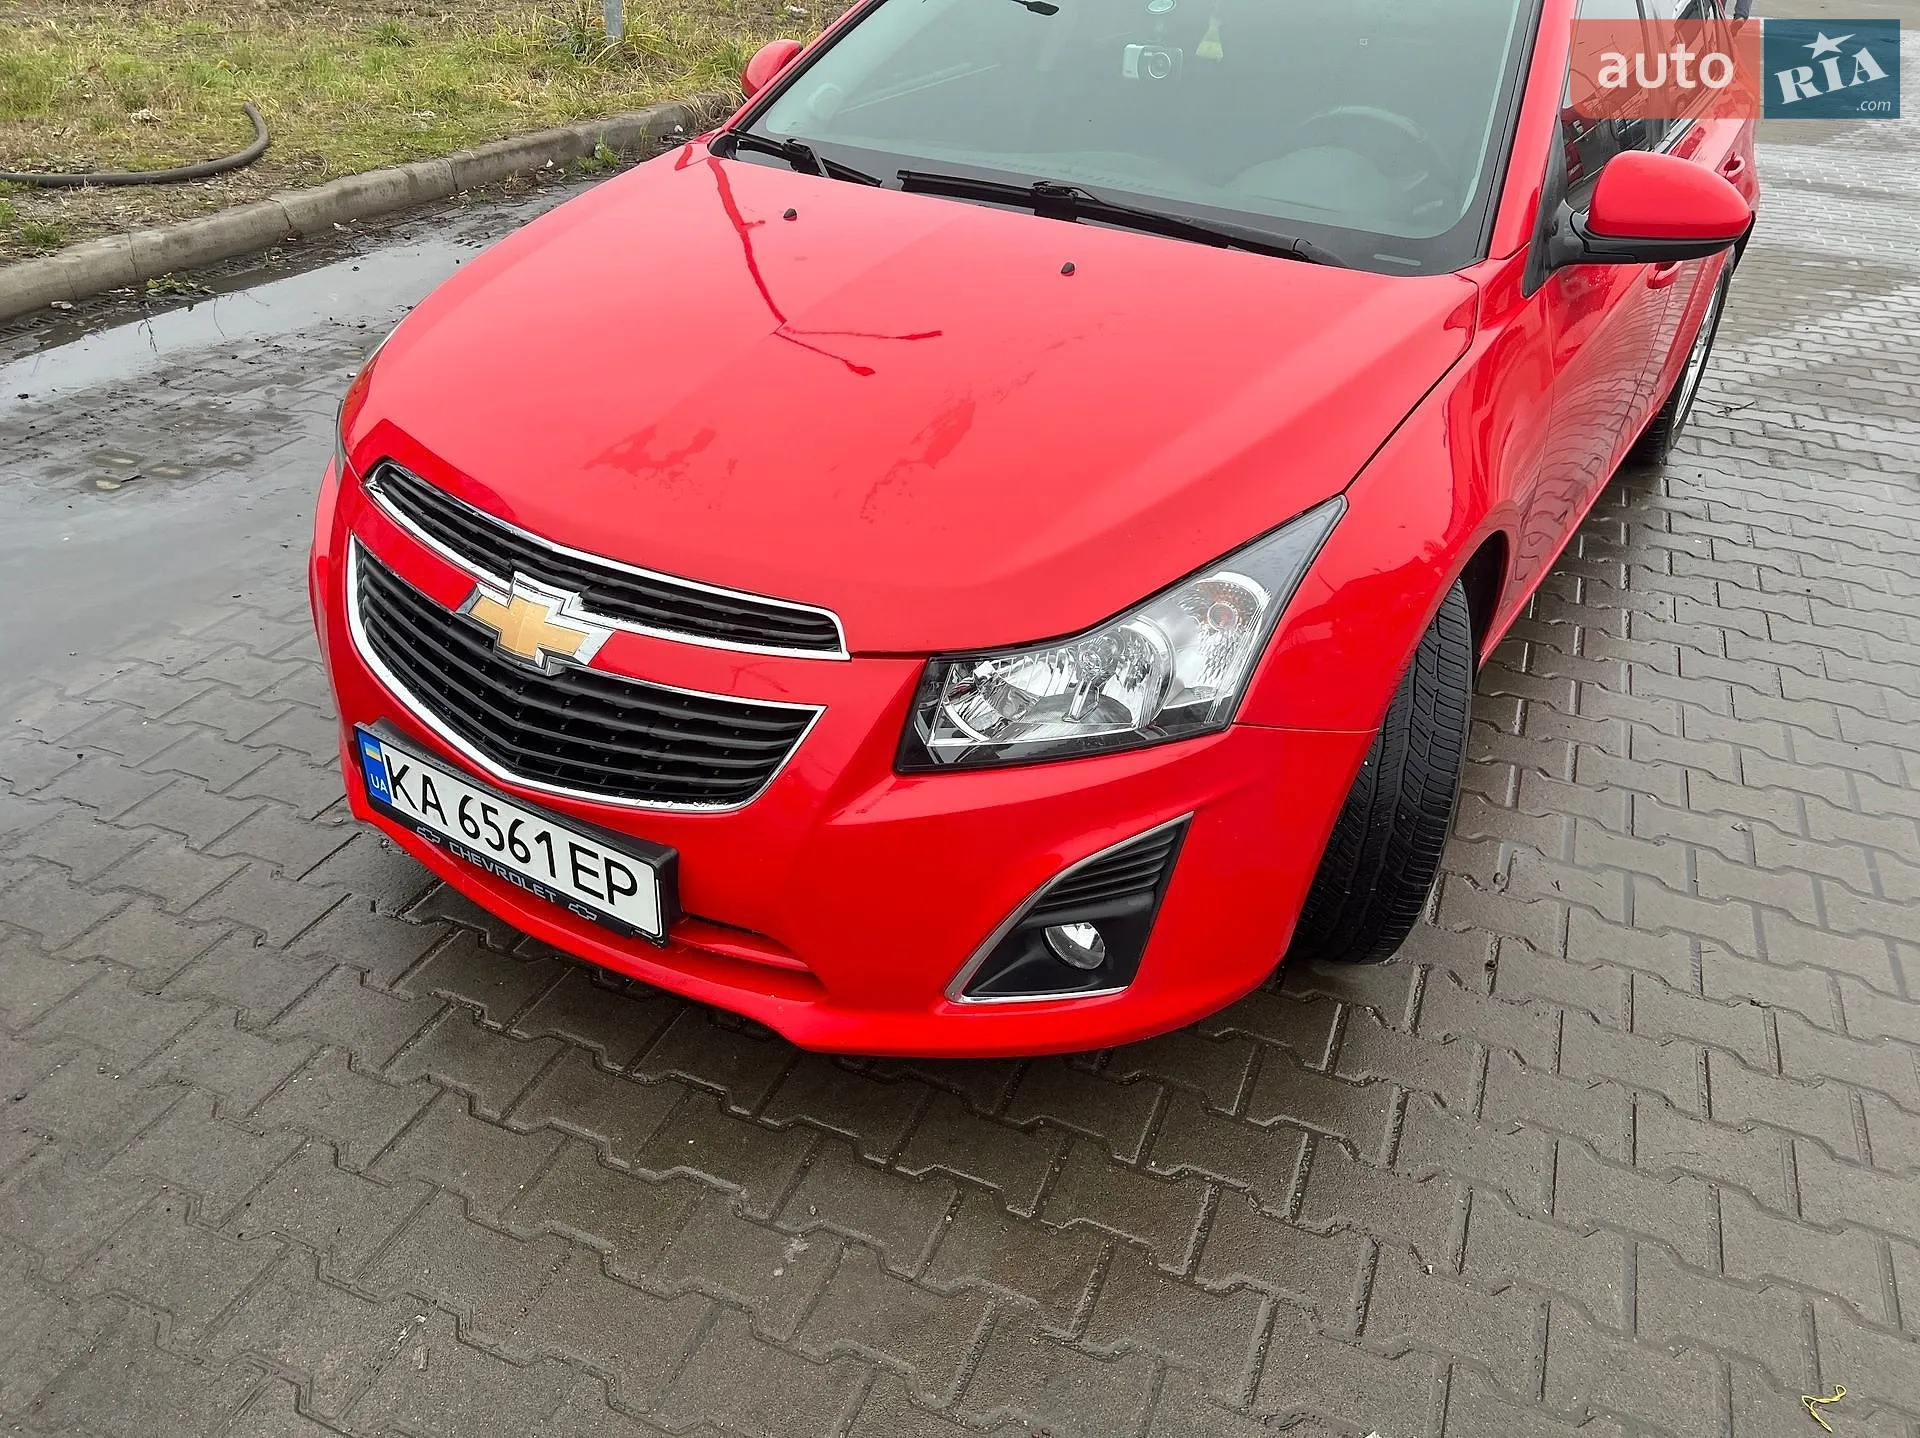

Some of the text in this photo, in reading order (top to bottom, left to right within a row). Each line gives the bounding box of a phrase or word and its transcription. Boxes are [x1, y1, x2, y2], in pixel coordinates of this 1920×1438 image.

[371, 774, 389, 795] UA
[384, 754, 638, 905] KA 6561 EP
[449, 841, 556, 903] CHEVROLET
